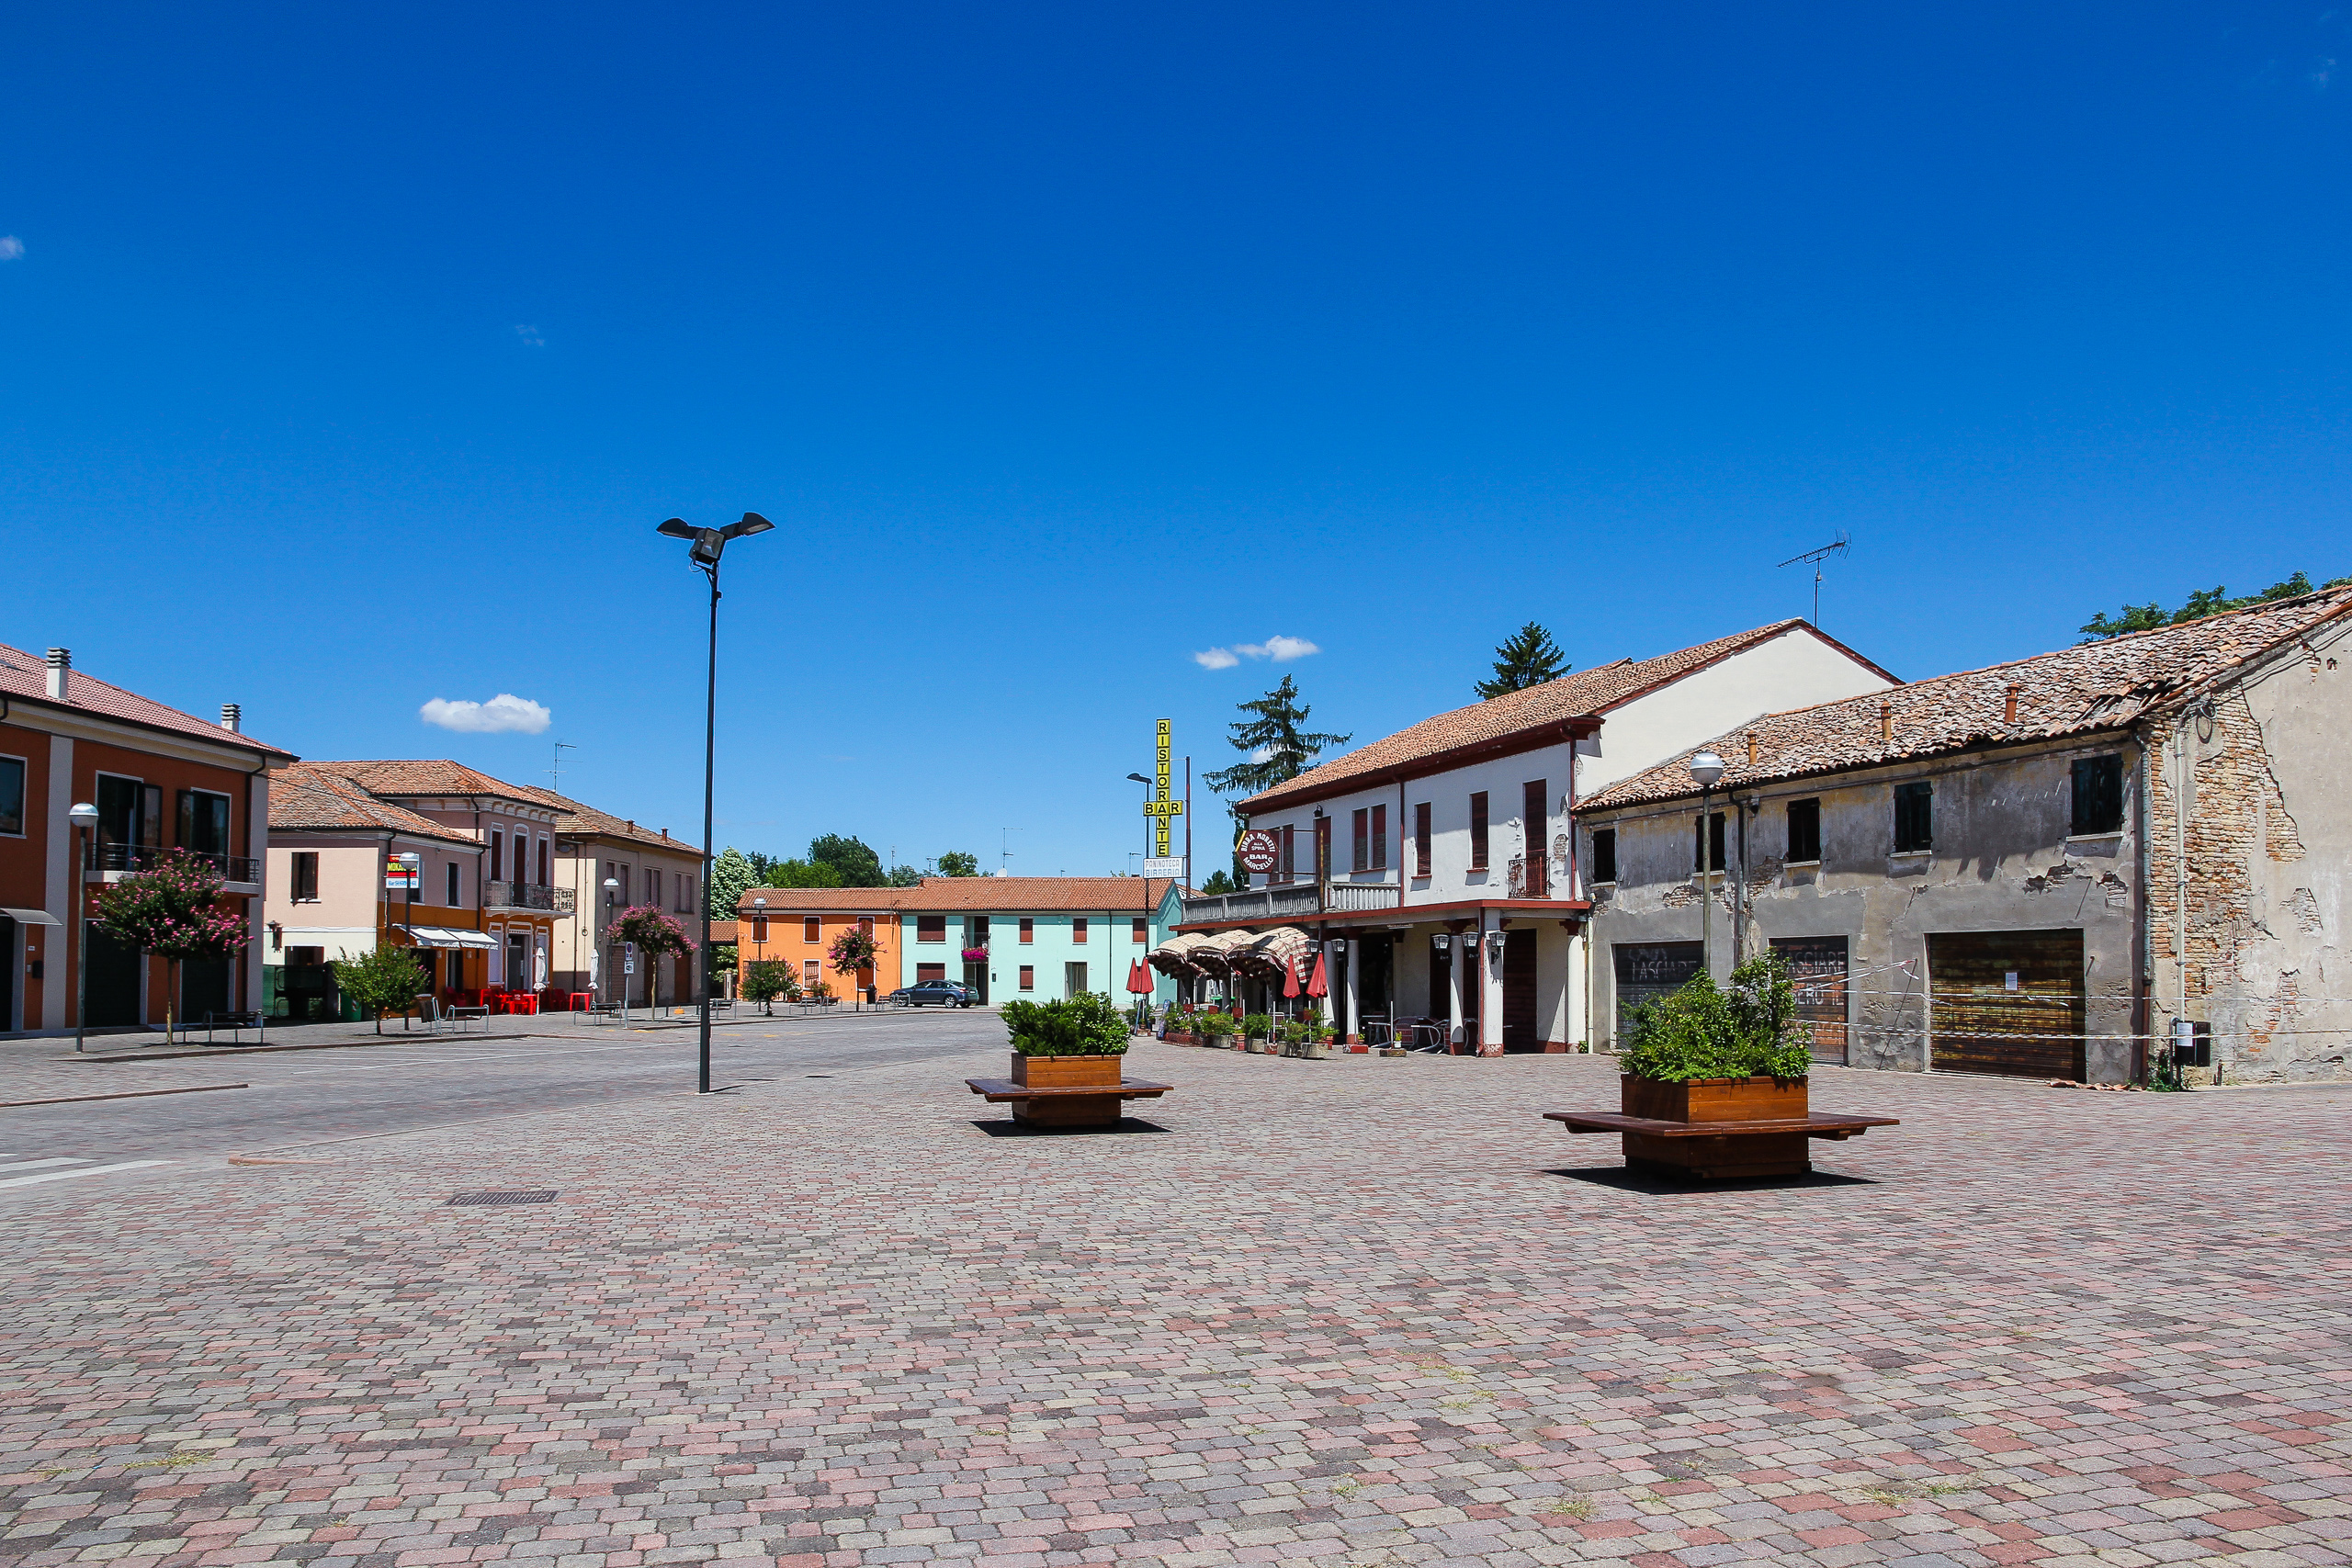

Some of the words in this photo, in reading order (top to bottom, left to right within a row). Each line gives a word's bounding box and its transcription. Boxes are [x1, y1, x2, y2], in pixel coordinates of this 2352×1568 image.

[1159, 721, 1167, 855] RISTORANTE
[1145, 802, 1180, 814] BAR
[1240, 833, 1256, 852] BIRRA
[1256, 831, 1276, 852] MORETTI
[1146, 859, 1180, 868] PANINOTECA
[1242, 856, 1274, 871] MARCELLO
[1146, 868, 1180, 877] BIRRERIA
